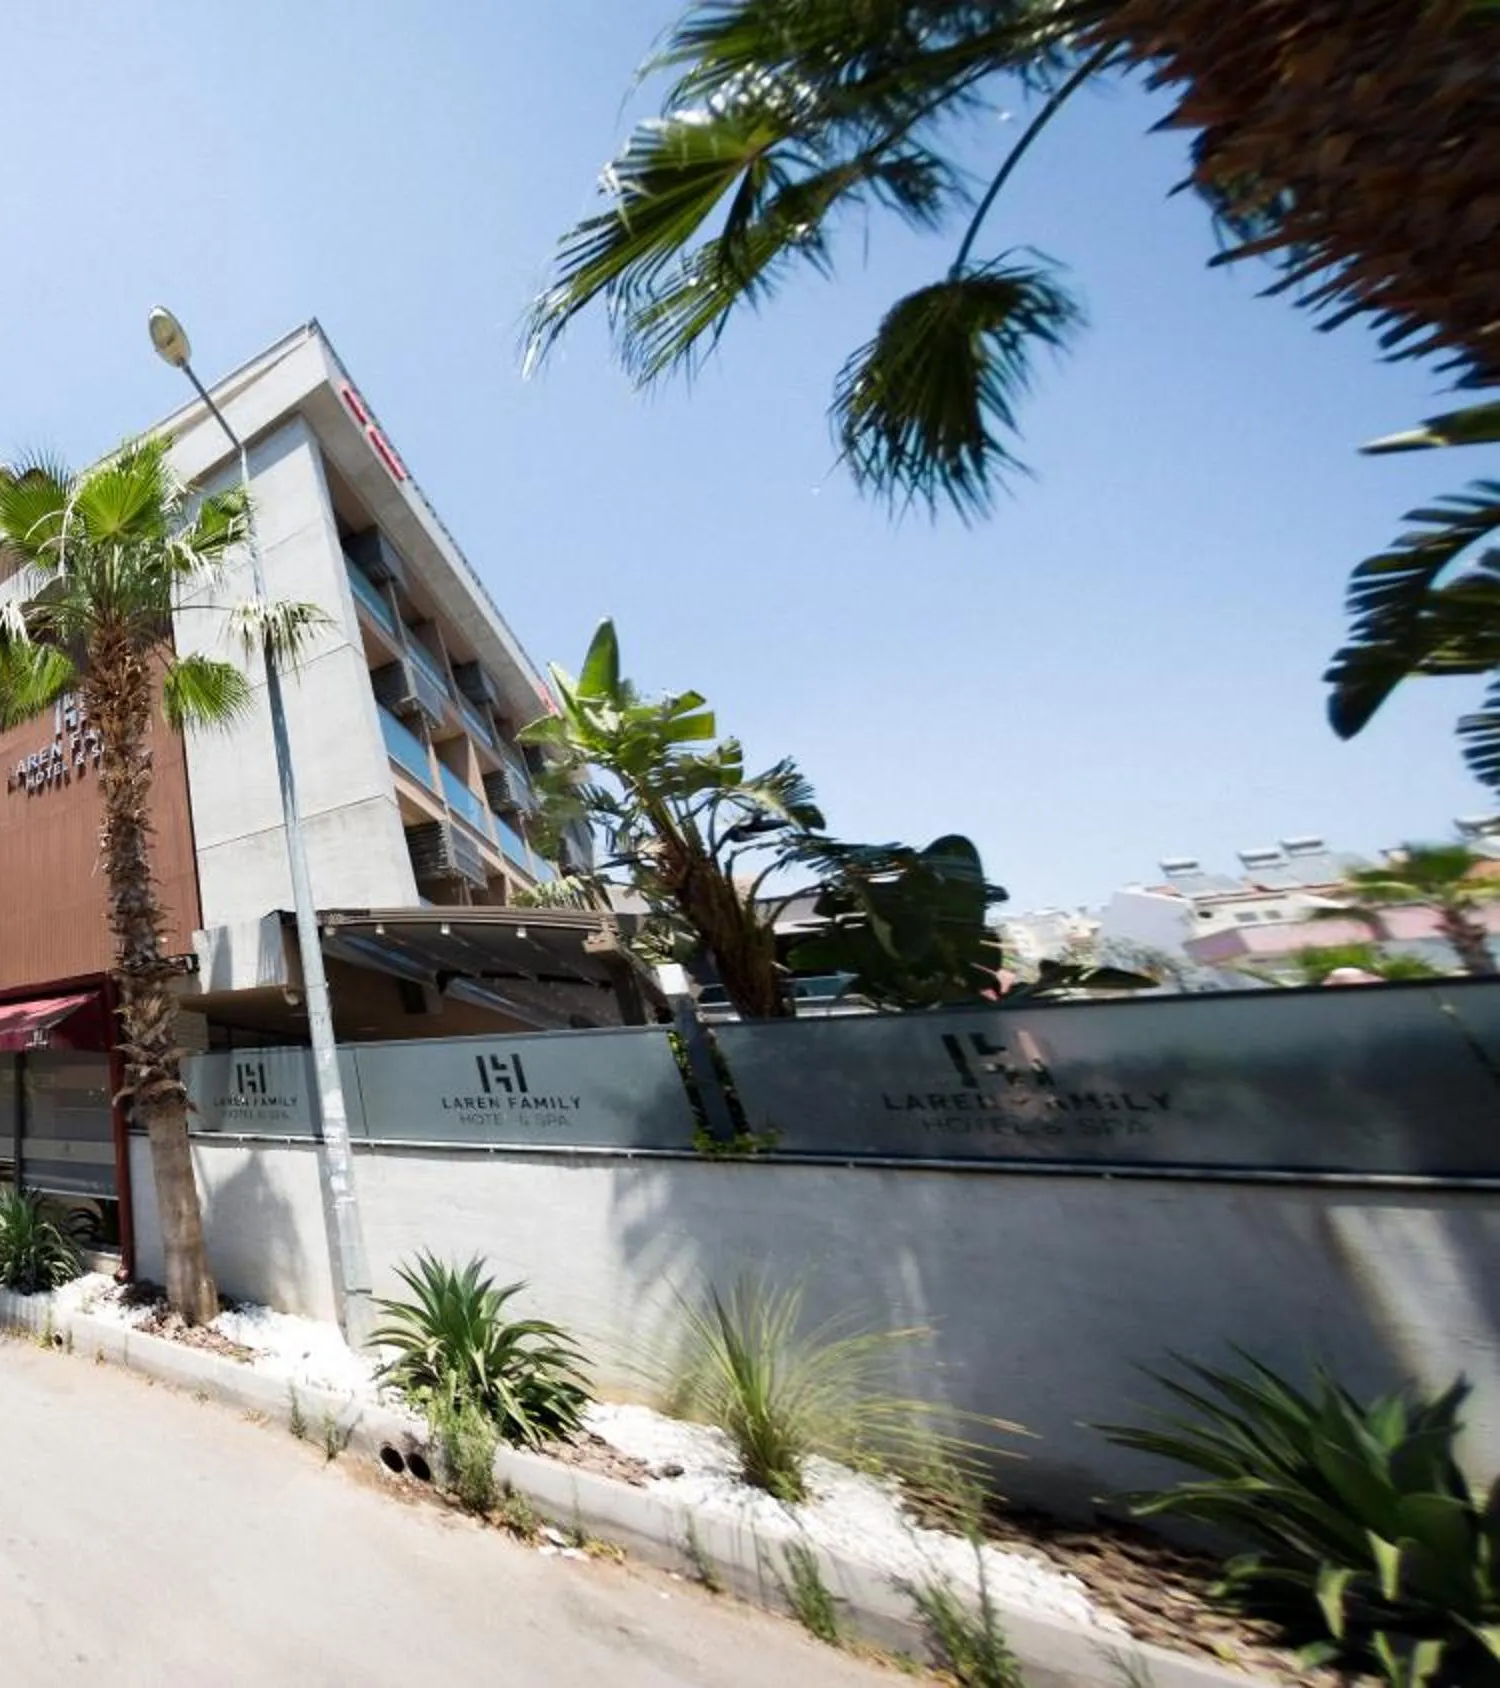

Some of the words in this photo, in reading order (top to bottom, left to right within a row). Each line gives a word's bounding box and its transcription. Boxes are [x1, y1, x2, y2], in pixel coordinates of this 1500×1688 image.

[441, 1097, 501, 1110] LAREN
[507, 1096, 581, 1110] FAMILY
[1010, 1092, 1173, 1112] AMILY
[459, 1113, 505, 1126] HOTE
